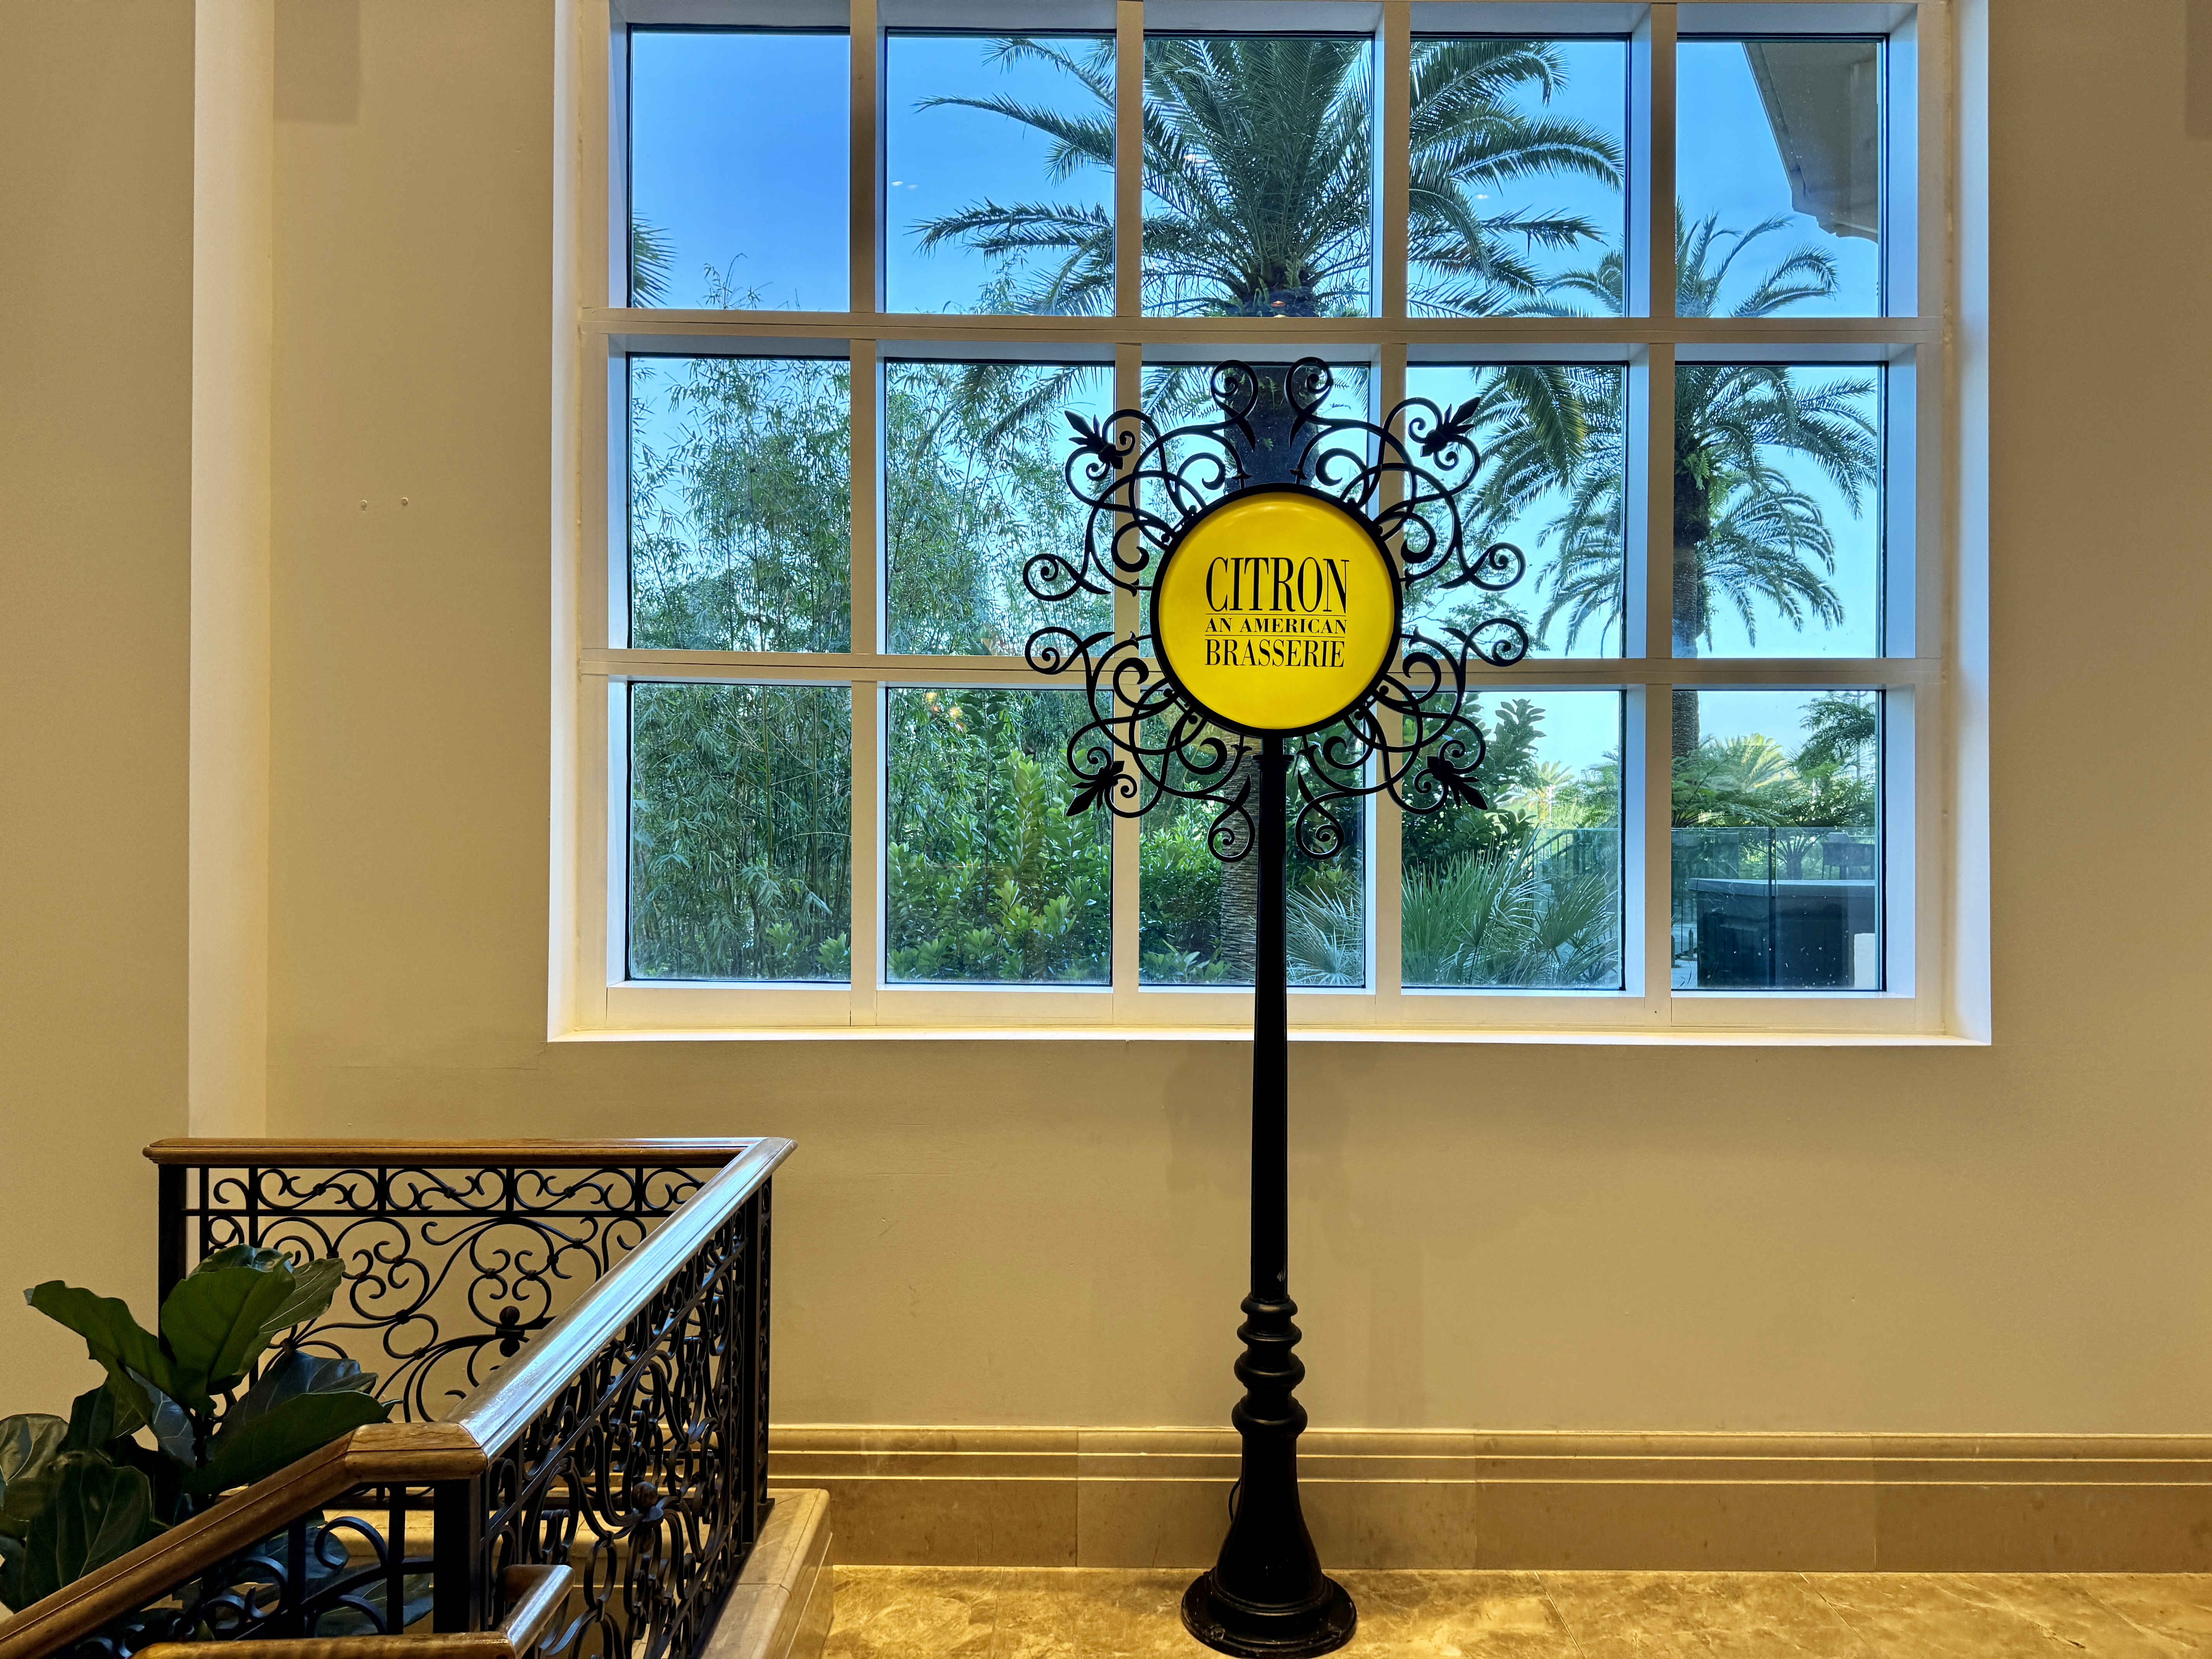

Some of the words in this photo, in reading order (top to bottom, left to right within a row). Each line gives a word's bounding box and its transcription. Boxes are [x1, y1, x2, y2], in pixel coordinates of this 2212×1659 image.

[1206, 556, 1350, 614] CITRON
[1205, 618, 1232, 632] AN
[1239, 618, 1347, 634] AMERICAN
[1205, 639, 1345, 667] BRASSERIE
